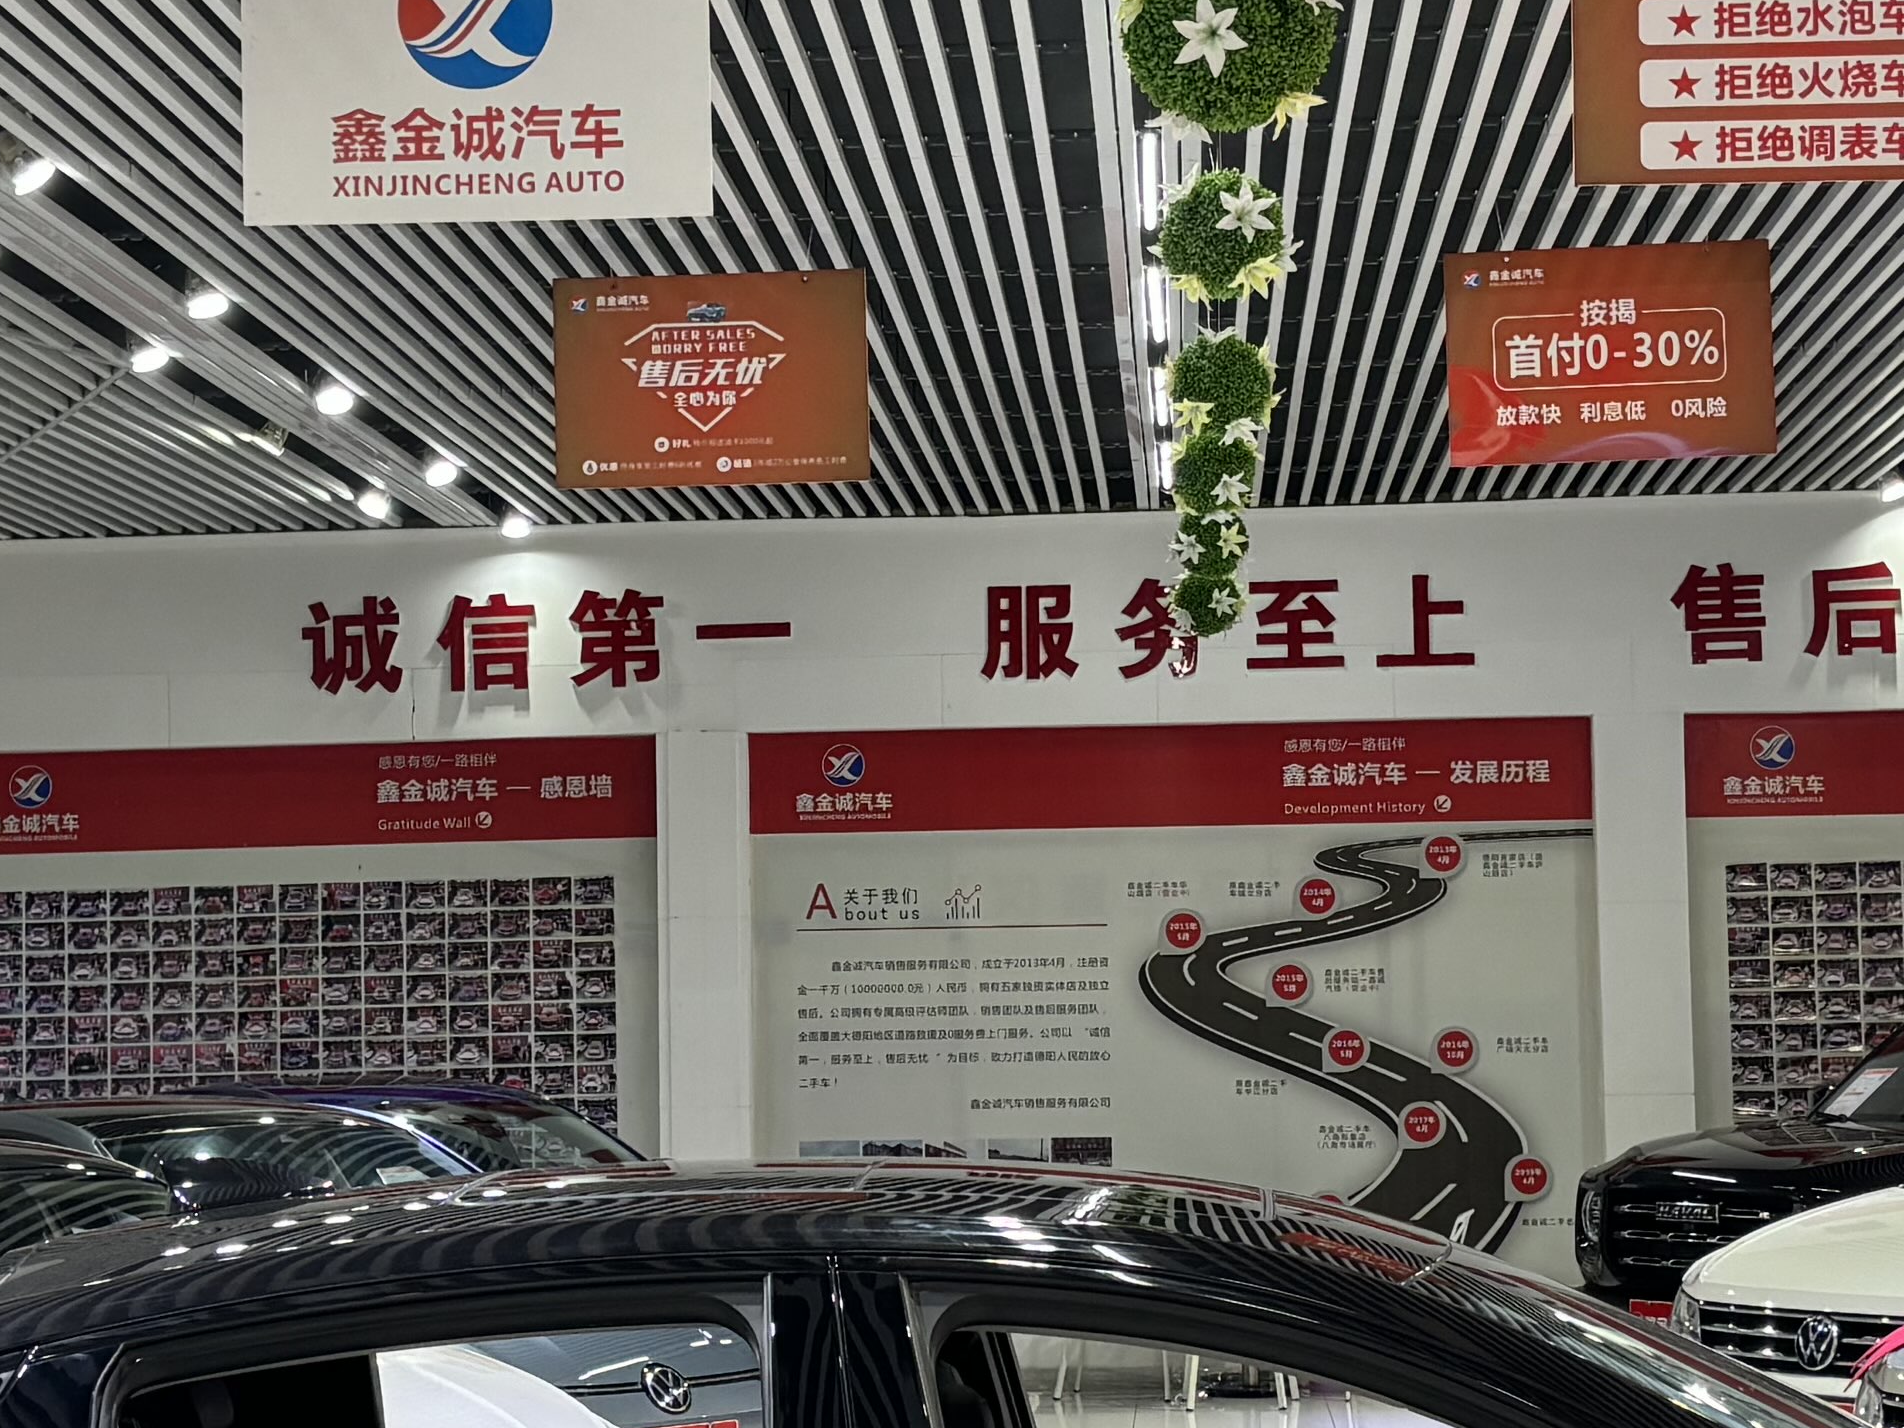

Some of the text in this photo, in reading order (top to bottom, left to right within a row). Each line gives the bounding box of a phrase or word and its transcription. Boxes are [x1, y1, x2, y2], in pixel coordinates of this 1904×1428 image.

[331, 103, 625, 165] 鑫金诚汽车
[333, 170, 625, 198] XINJINCHENG AUTO
[1580, 298, 1637, 327] 按揭
[652, 328, 756, 342] AFTER SALES
[708, 341, 747, 353] FREE
[1505, 328, 1720, 379] 首付0-30%
[638, 356, 766, 388] 售后无忧
[673, 390, 737, 408] 全心为你
[1496, 396, 1728, 427] 放款快 利息低 0风险
[301, 589, 791, 696] 诚信第一
[979, 574, 1476, 681] 服务至上
[1282, 761, 1408, 787] 鑫金诚汽车
[1450, 759, 1550, 785] 发展历程
[377, 777, 498, 804] 鑫金诚汽车
[540, 774, 613, 800] 感恩墙
[1723, 775, 1825, 796] 鑫金诚汽车
[796, 792, 893, 813] 鑫金诚汽车
[1284, 801, 1425, 817] Development History
[378, 817, 471, 831] Gratitude Wall
[844, 887, 919, 906] 关于我们
[899, 907, 920, 921] us
